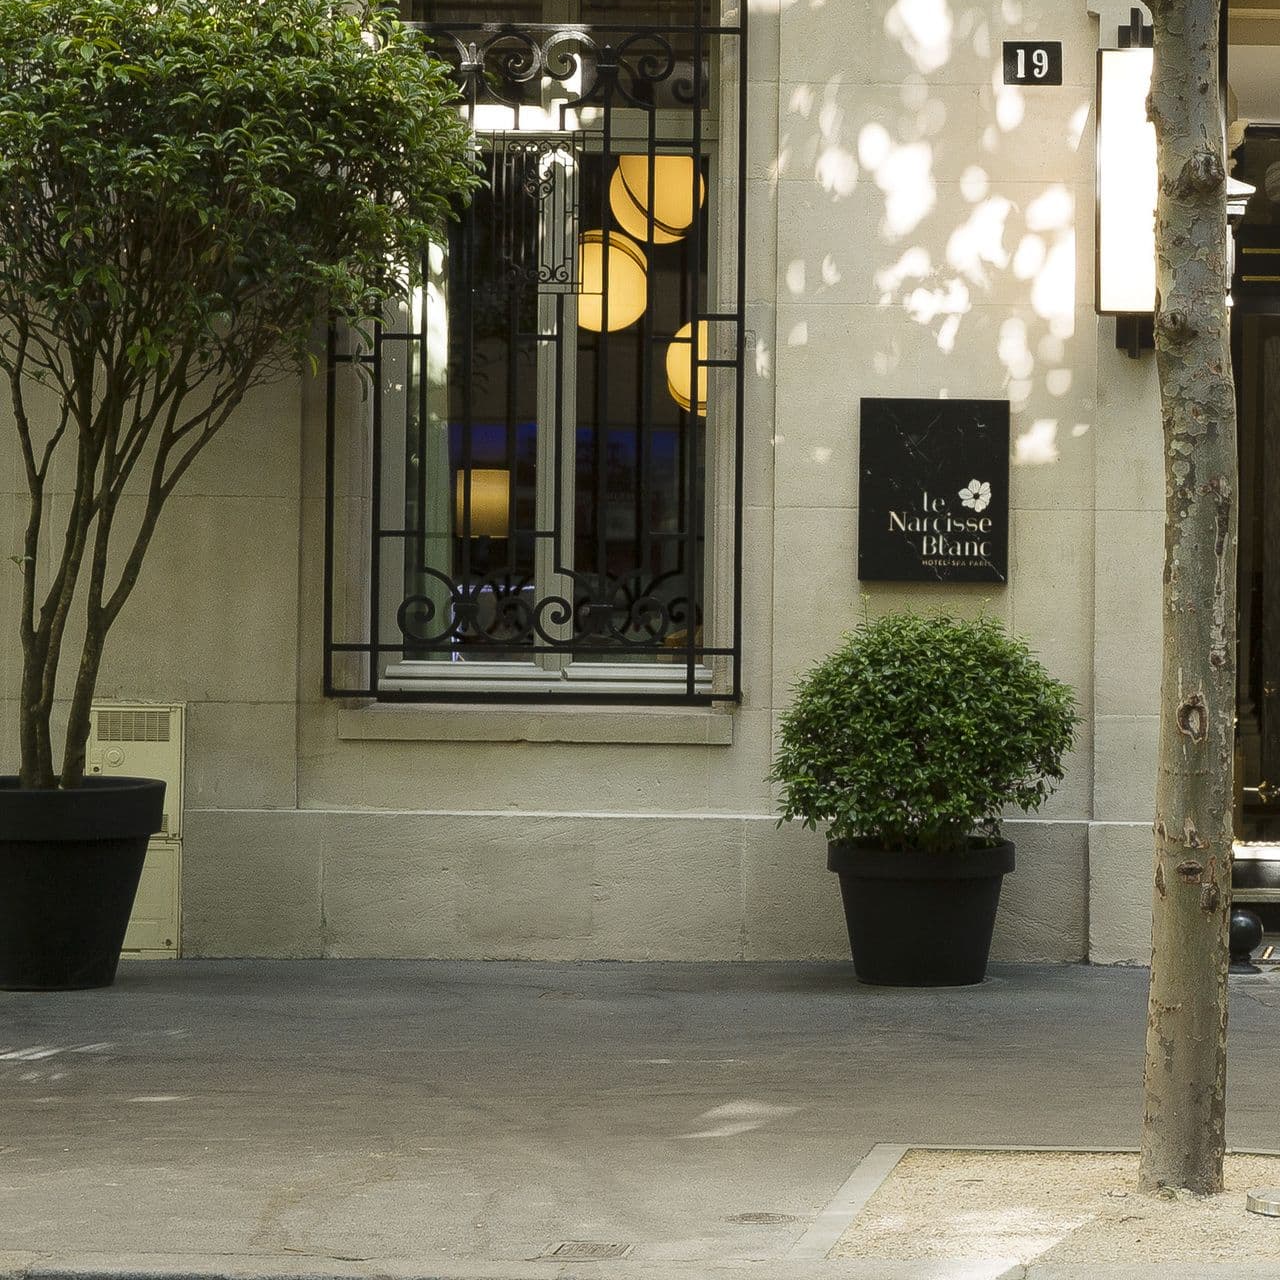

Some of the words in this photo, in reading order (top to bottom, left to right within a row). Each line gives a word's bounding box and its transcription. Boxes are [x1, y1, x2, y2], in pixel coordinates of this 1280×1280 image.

[1016, 49, 1049, 79] 19
[923, 491, 946, 512] le
[888, 511, 992, 533] Narcisse
[921, 534, 992, 556] Blanc
